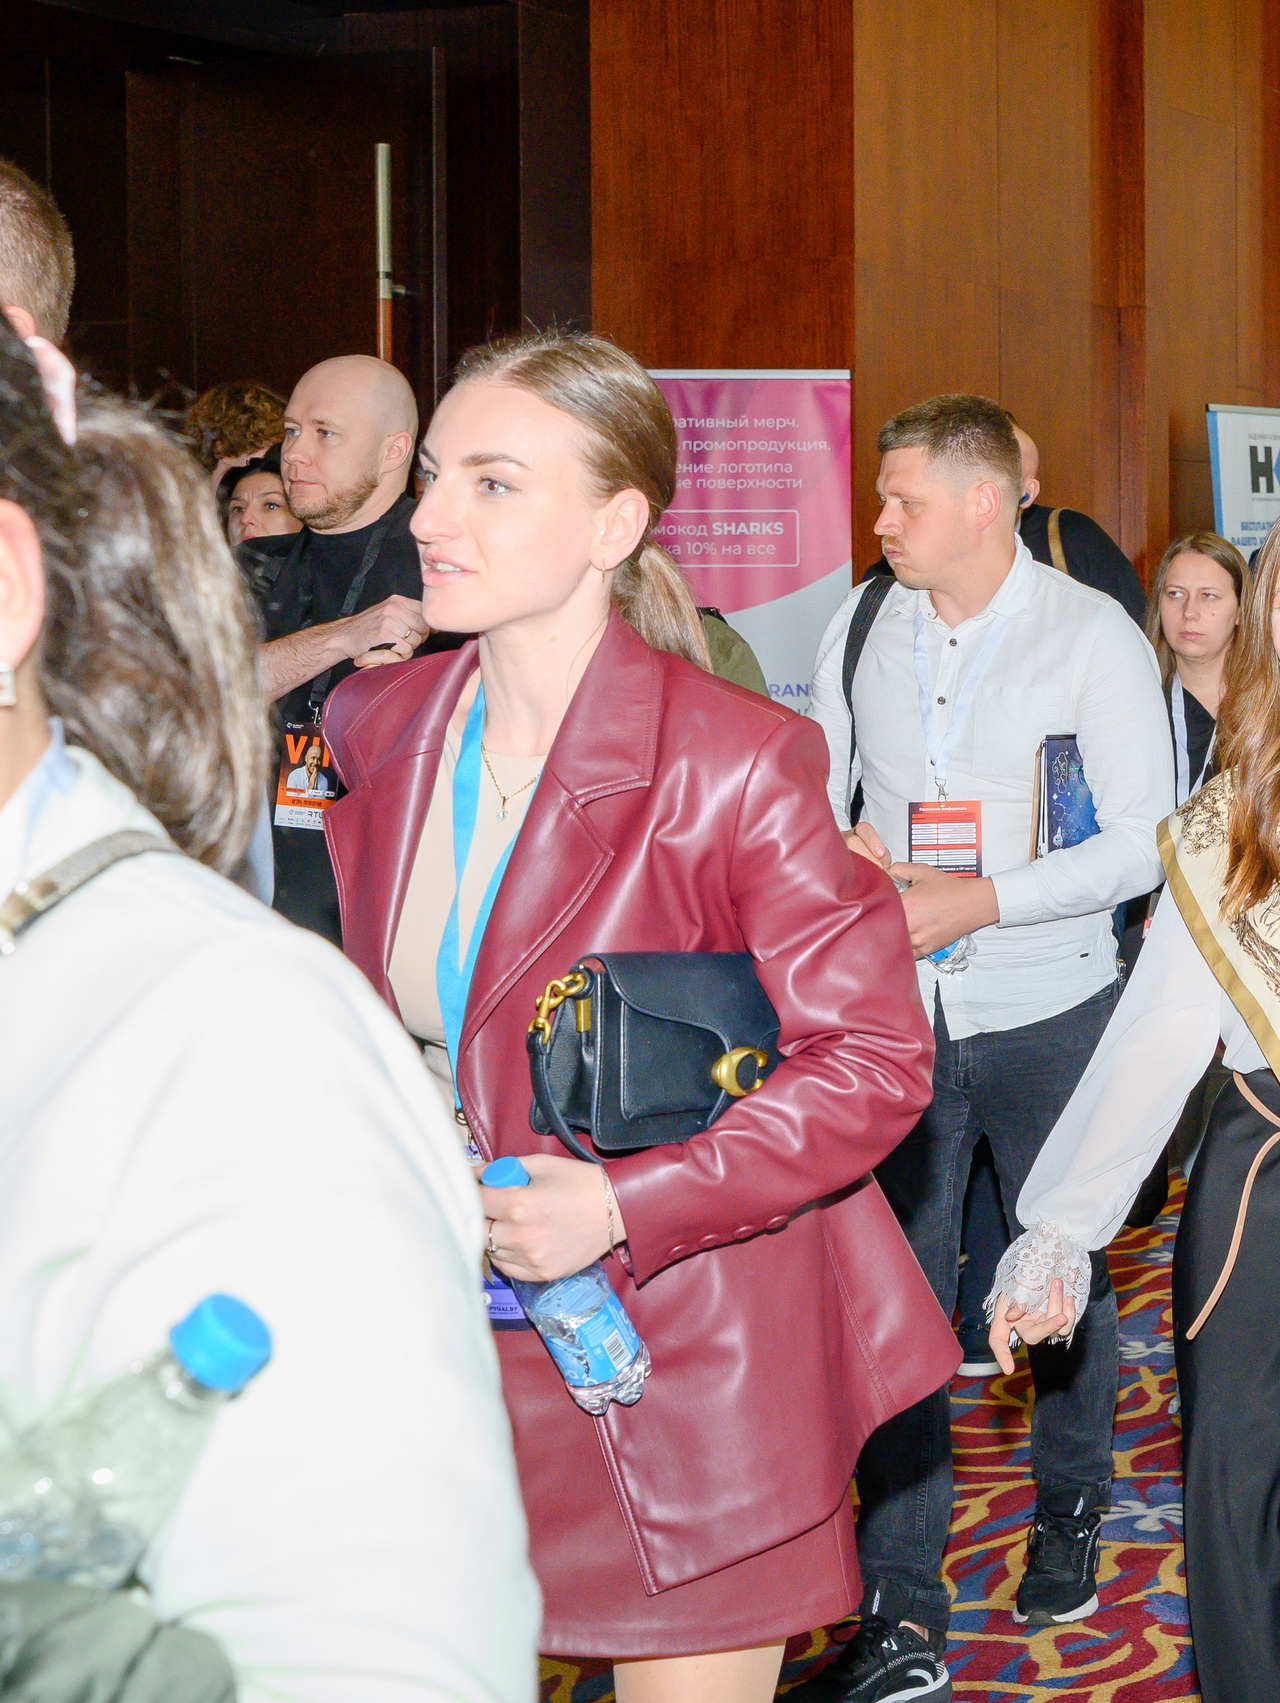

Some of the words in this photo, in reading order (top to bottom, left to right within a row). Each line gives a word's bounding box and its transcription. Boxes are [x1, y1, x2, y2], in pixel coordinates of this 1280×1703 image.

[754, 417, 800, 431] мерч.
[682, 440, 831, 454] промопродукция.
[717, 463, 793, 474] логотипа
[696, 478, 803, 491] поверхности
[712, 522, 784, 536] SHARKS
[686, 542, 718, 556] 10%
[722, 544, 742, 555] на
[747, 544, 776, 555] все
